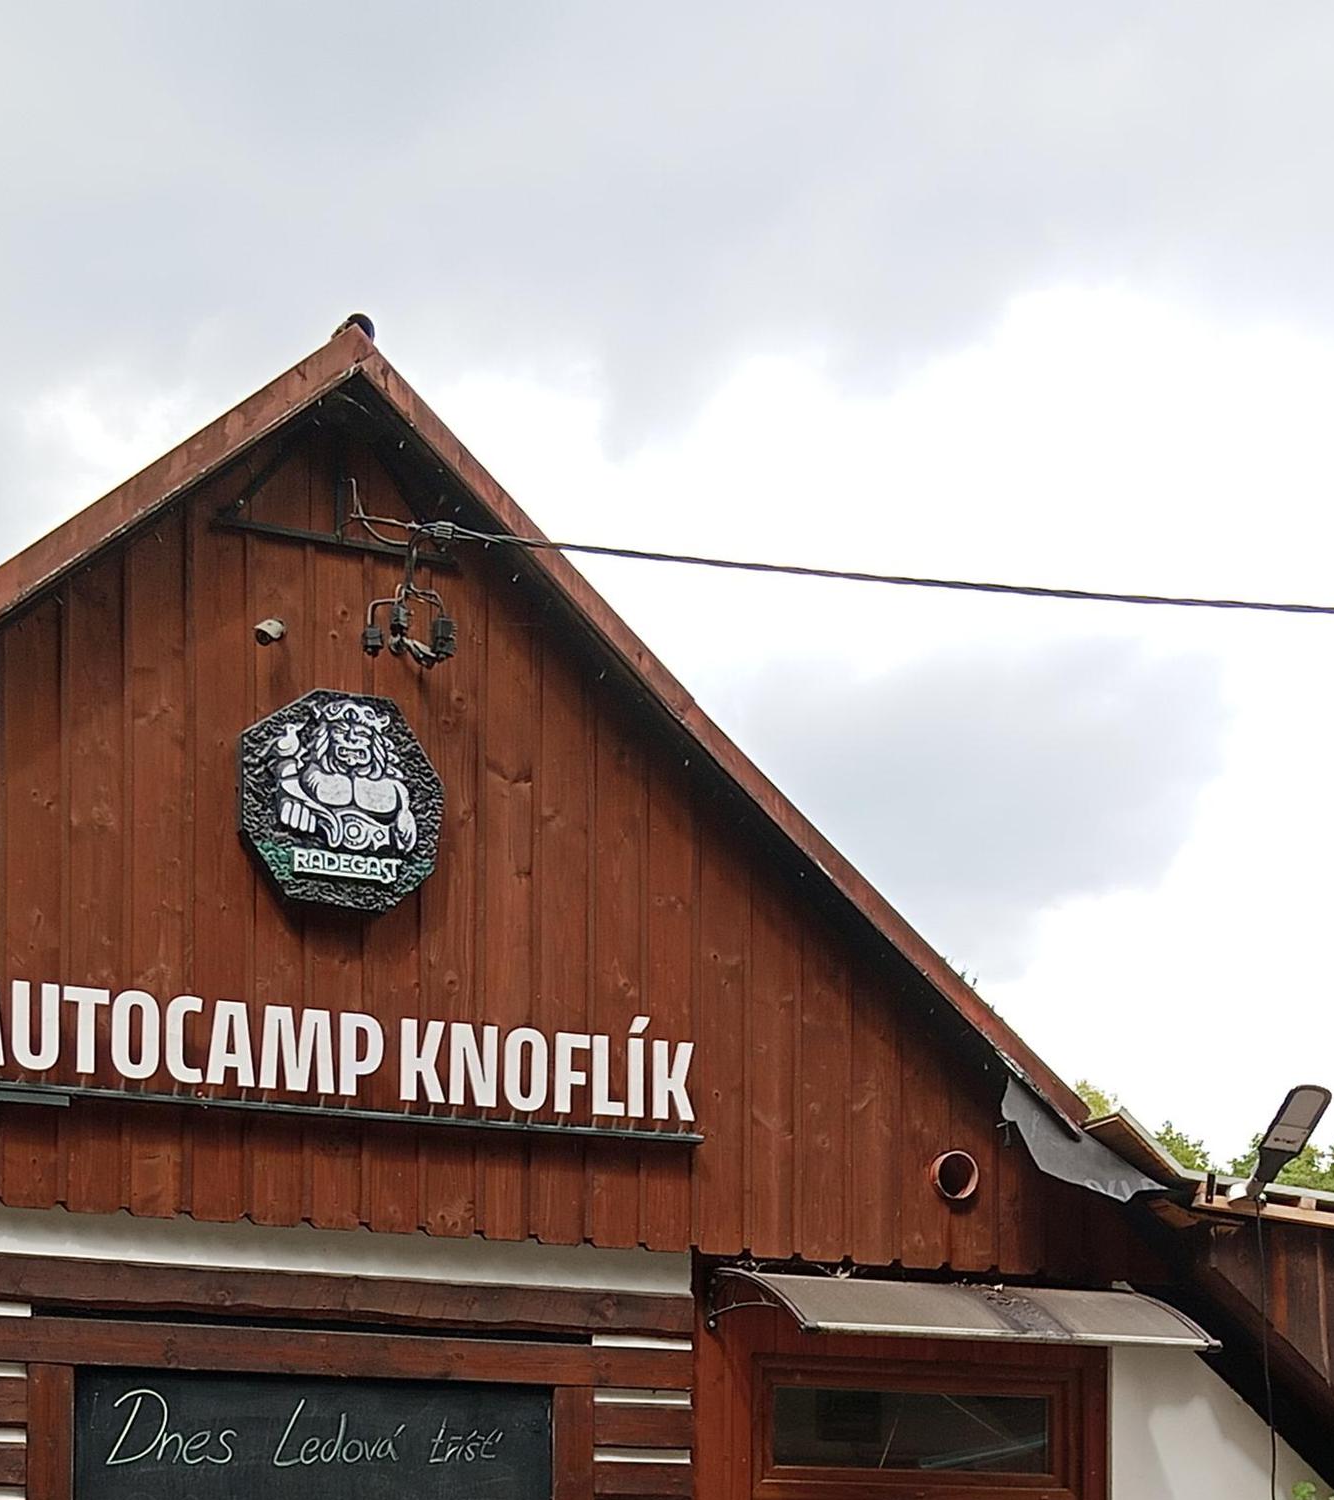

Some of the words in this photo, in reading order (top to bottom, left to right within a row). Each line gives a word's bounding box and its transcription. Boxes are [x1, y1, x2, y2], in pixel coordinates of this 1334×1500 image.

[294, 848, 403, 883] RADEGAST
[399, 1016, 694, 1122] KNOFLÍK
[105, 1388, 238, 1465] Dnes
[272, 1398, 405, 1467] Ledová
